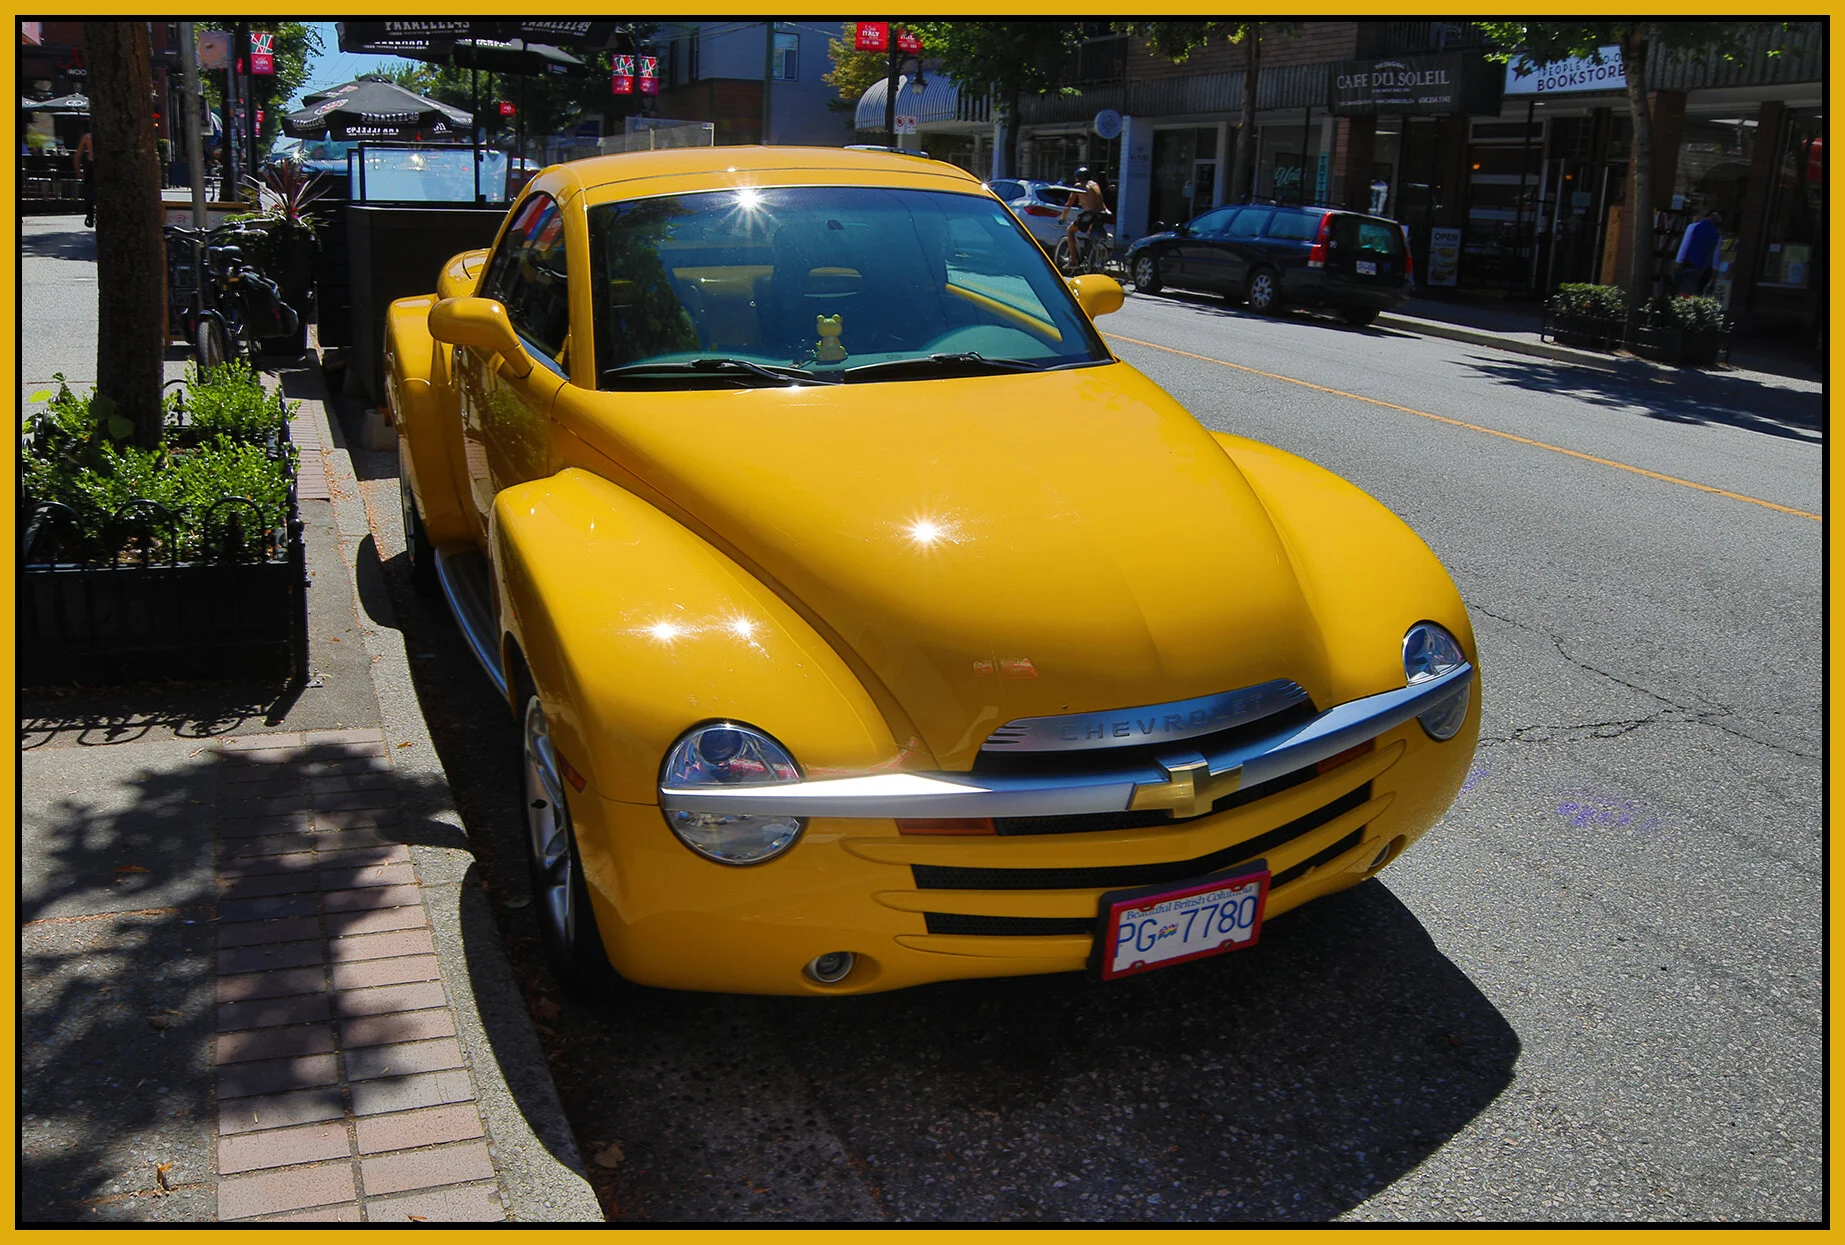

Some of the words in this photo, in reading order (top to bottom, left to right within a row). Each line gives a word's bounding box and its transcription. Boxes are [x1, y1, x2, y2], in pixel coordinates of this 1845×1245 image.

[1372, 72, 1394, 87] DU
[1398, 70, 1450, 86] SOLEIL
[1537, 63, 1626, 91] BOOKSTORE
[1434, 232, 1458, 241] OPEN
[1060, 694, 1264, 741] CHEVROLET
[1173, 897, 1206, 911] British
[1115, 918, 1158, 958] PG
[1180, 895, 1257, 943] 7780
